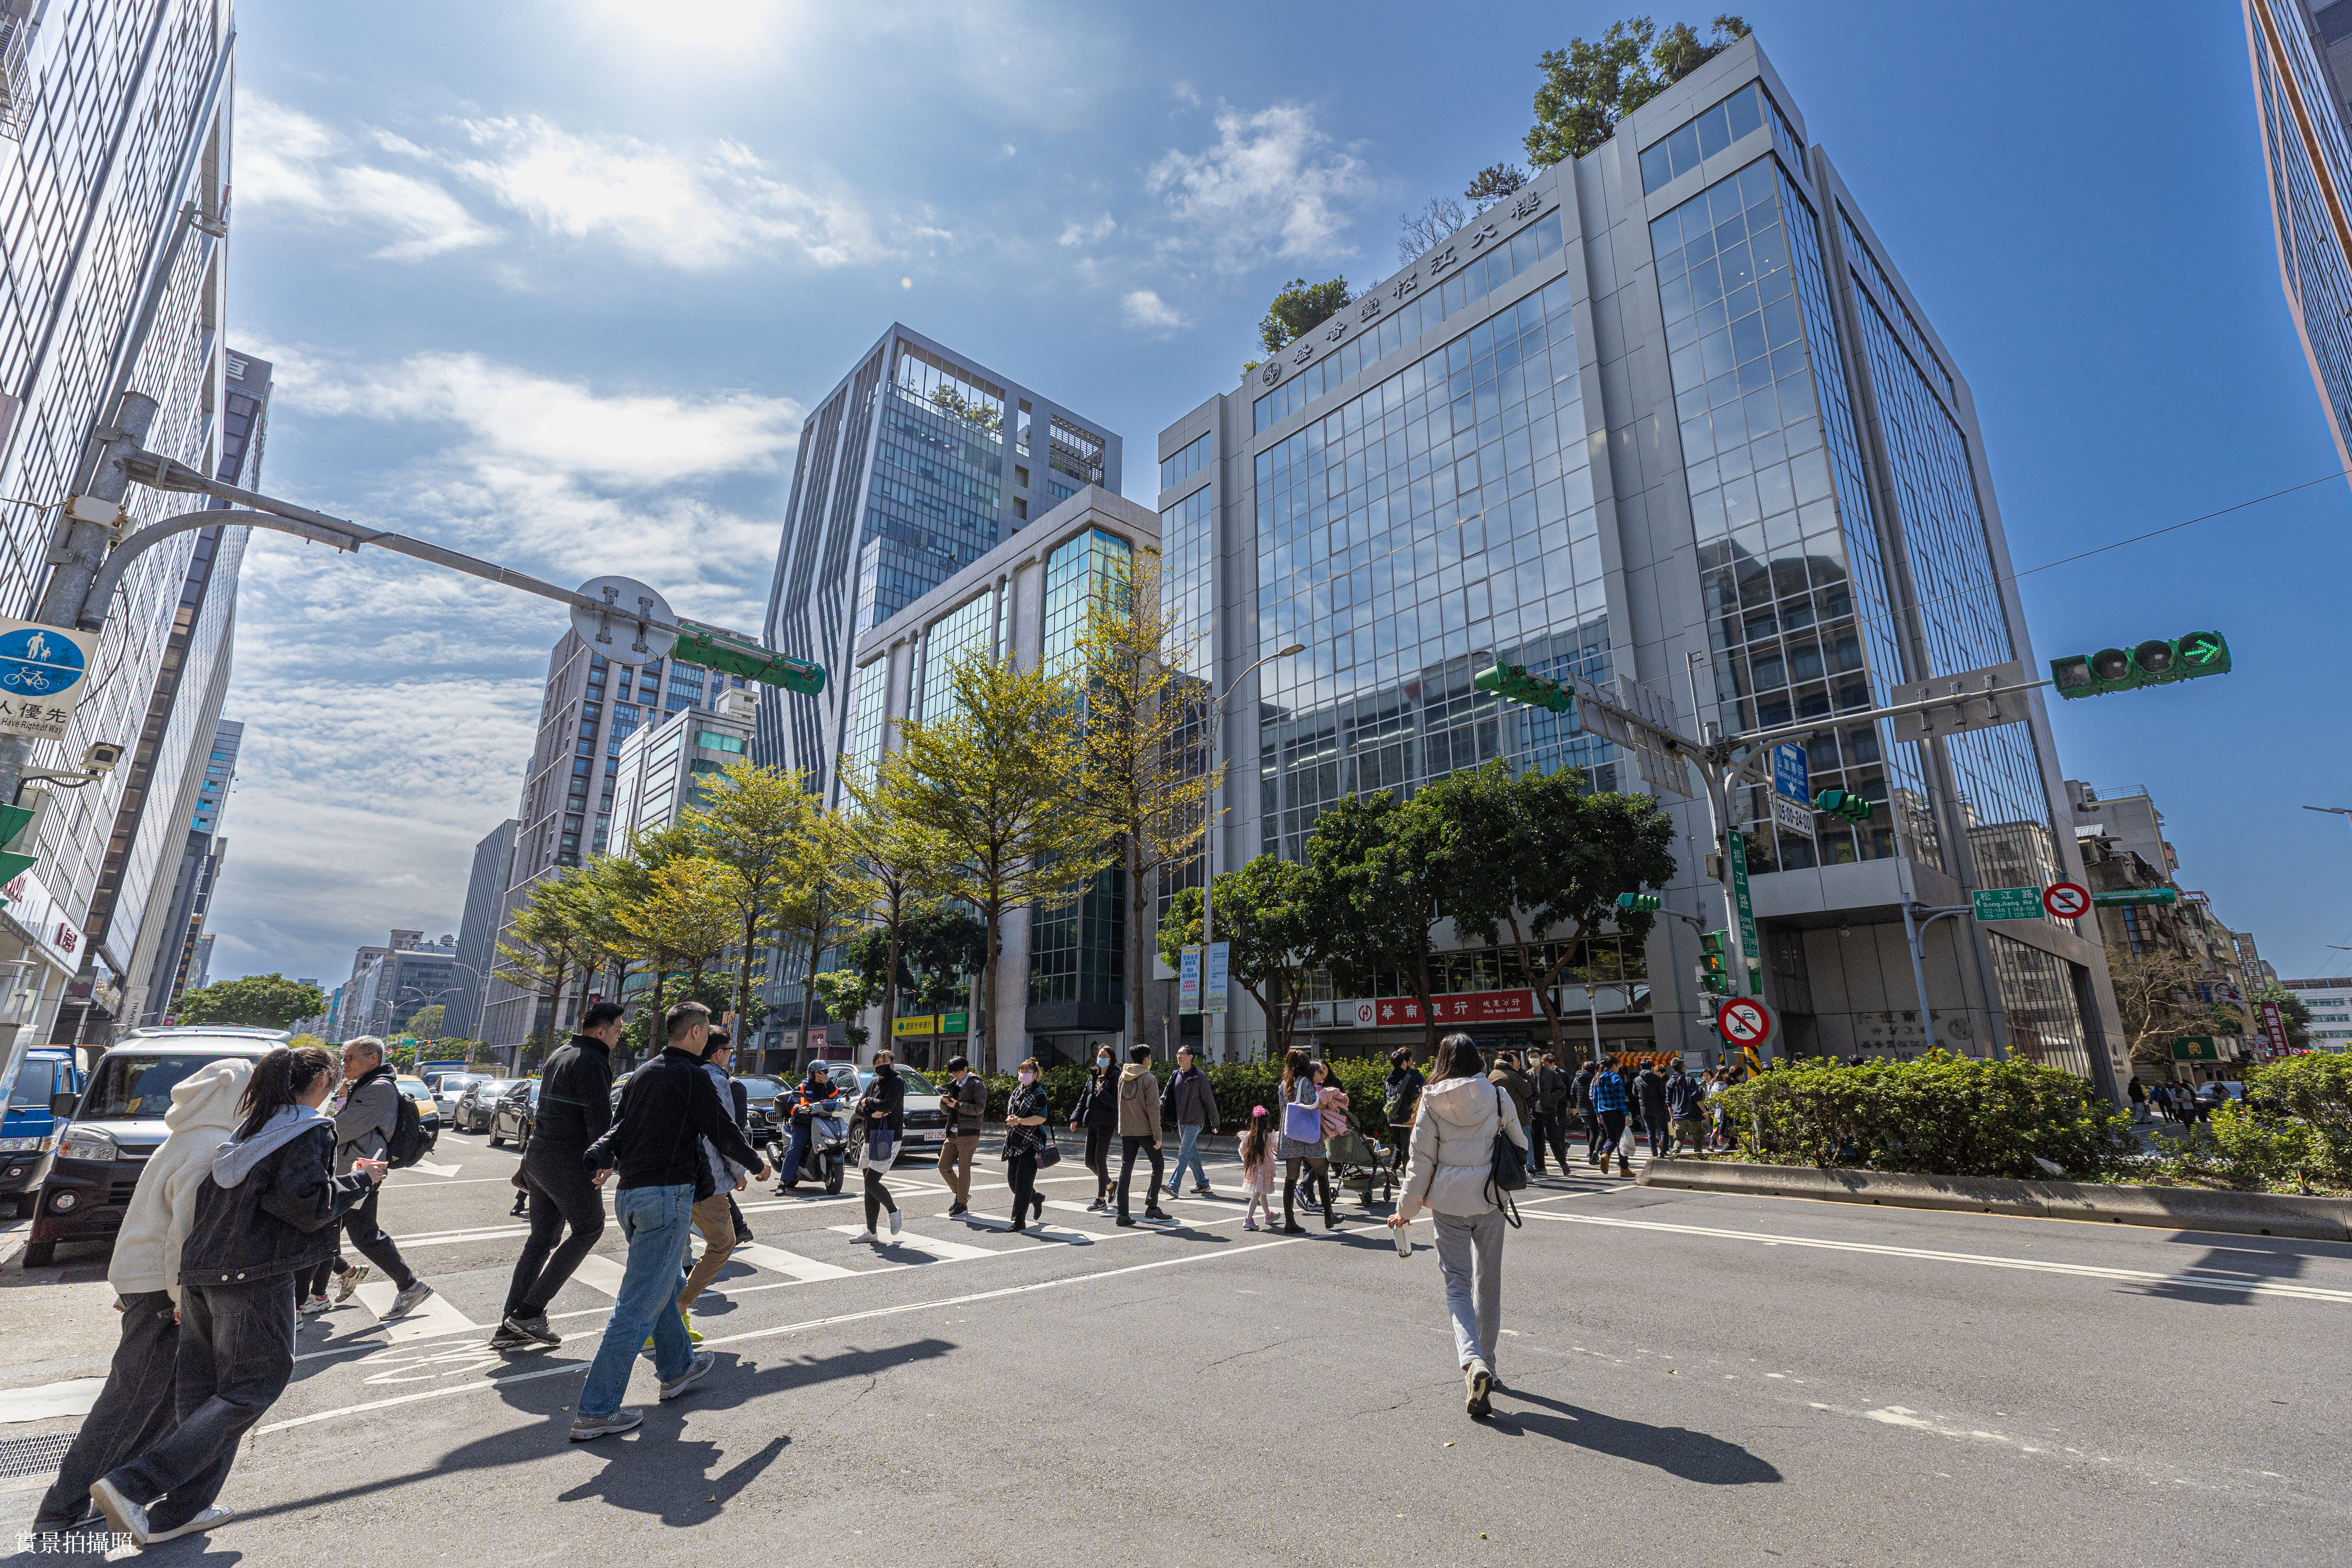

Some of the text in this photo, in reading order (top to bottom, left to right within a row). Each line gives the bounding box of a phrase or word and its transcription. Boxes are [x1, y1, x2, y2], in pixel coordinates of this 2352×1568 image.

[1293, 191, 1540, 365] 盛香堂松江大樓
[2, 718, 19, 727] Have
[20, 720, 39, 731] Right
[49, 725, 63, 735] Way
[1777, 754, 1804, 779] 公車專用
[1777, 768, 1791, 781] Exclusive
[1778, 803, 1810, 830] 05:00~24:00
[1734, 849, 1749, 909] 松江路
[1980, 889, 2034, 901] 松江路
[1740, 915, 1751, 925] Song
[1741, 923, 1753, 932] Jiang
[125, 1002, 139, 1032] TRAVELER
[1382, 1001, 1468, 1020] 華南銀行
[906, 1021, 932, 1031] 國泰世華銀行
